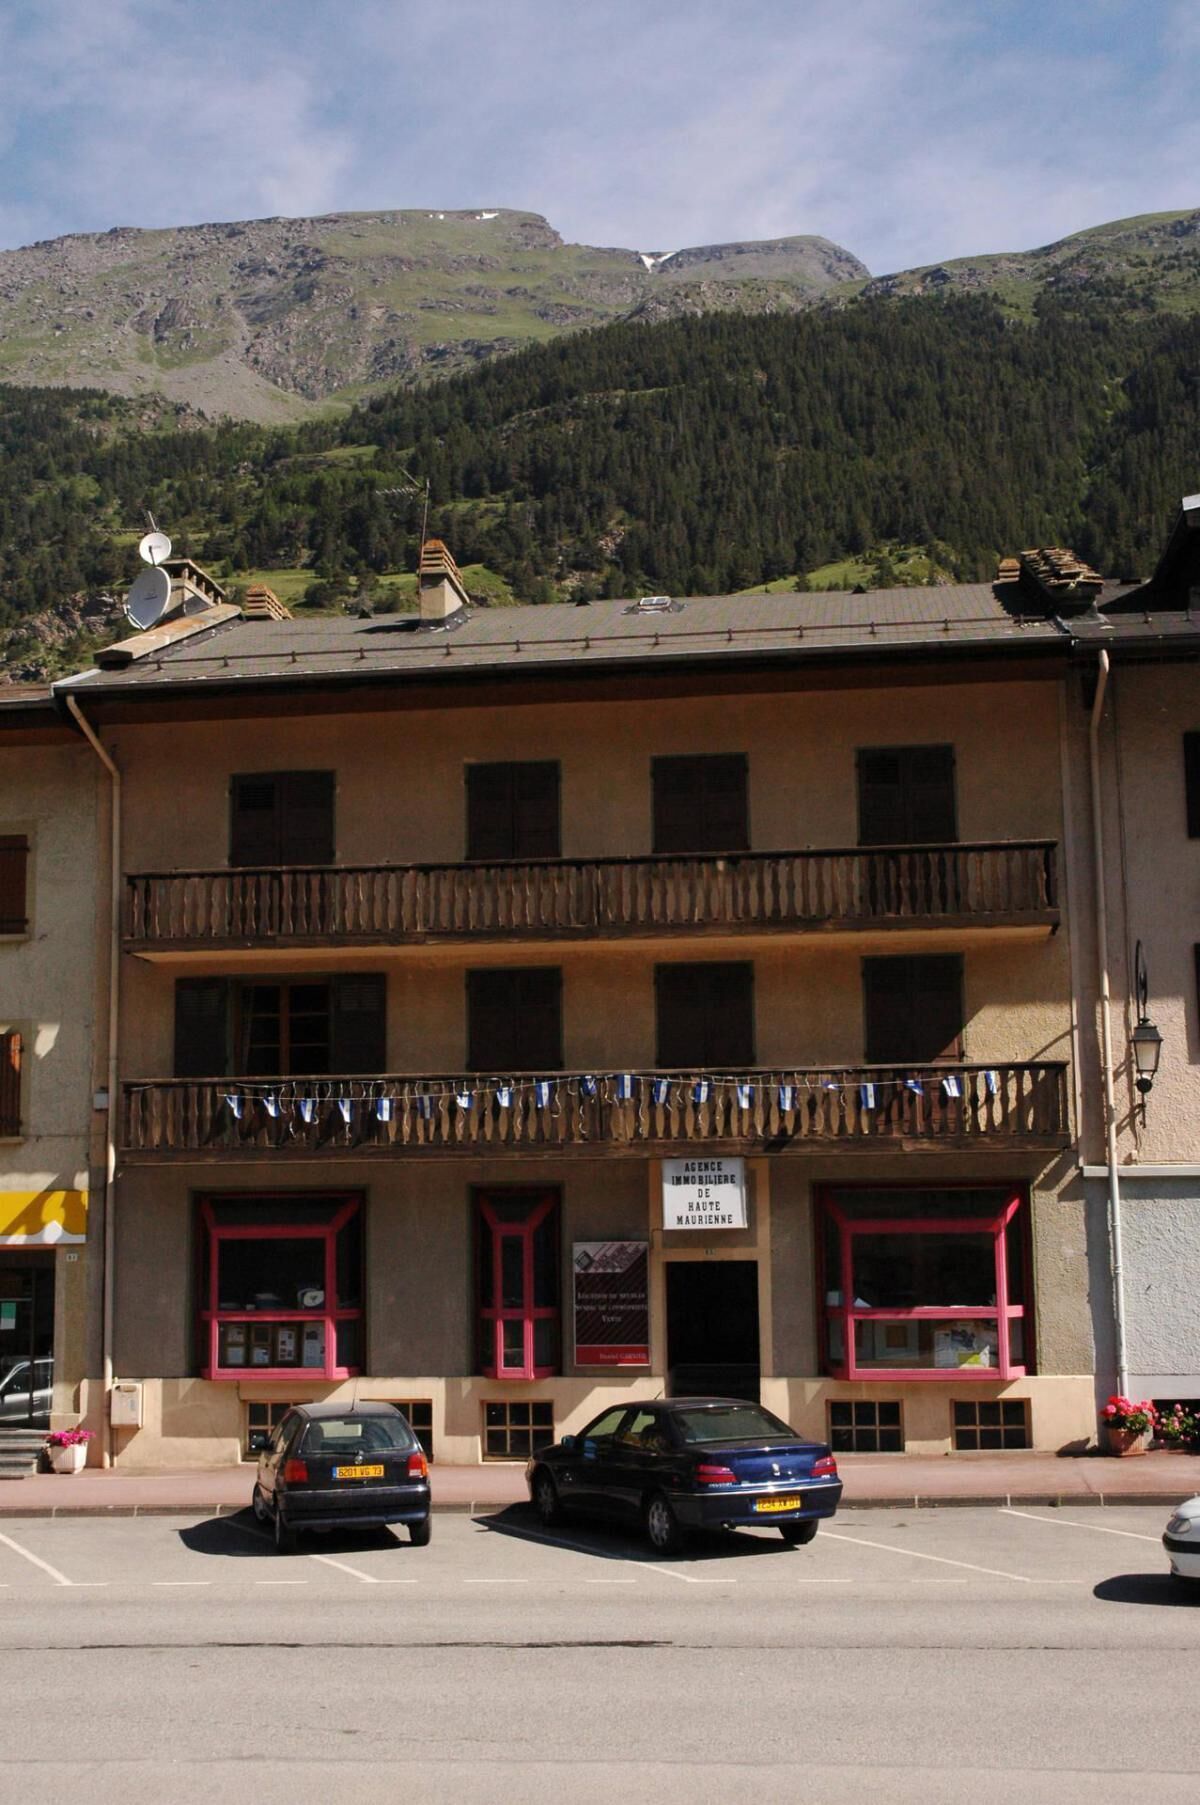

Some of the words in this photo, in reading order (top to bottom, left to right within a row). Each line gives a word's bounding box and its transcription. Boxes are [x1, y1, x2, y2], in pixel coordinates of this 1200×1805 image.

[685, 1161, 723, 1172] AGENCE
[697, 1188, 711, 1198] DE
[688, 1201, 721, 1212] HAUTE
[676, 1214, 734, 1225] MAURIENNE
[374, 1466, 382, 1475] 73
